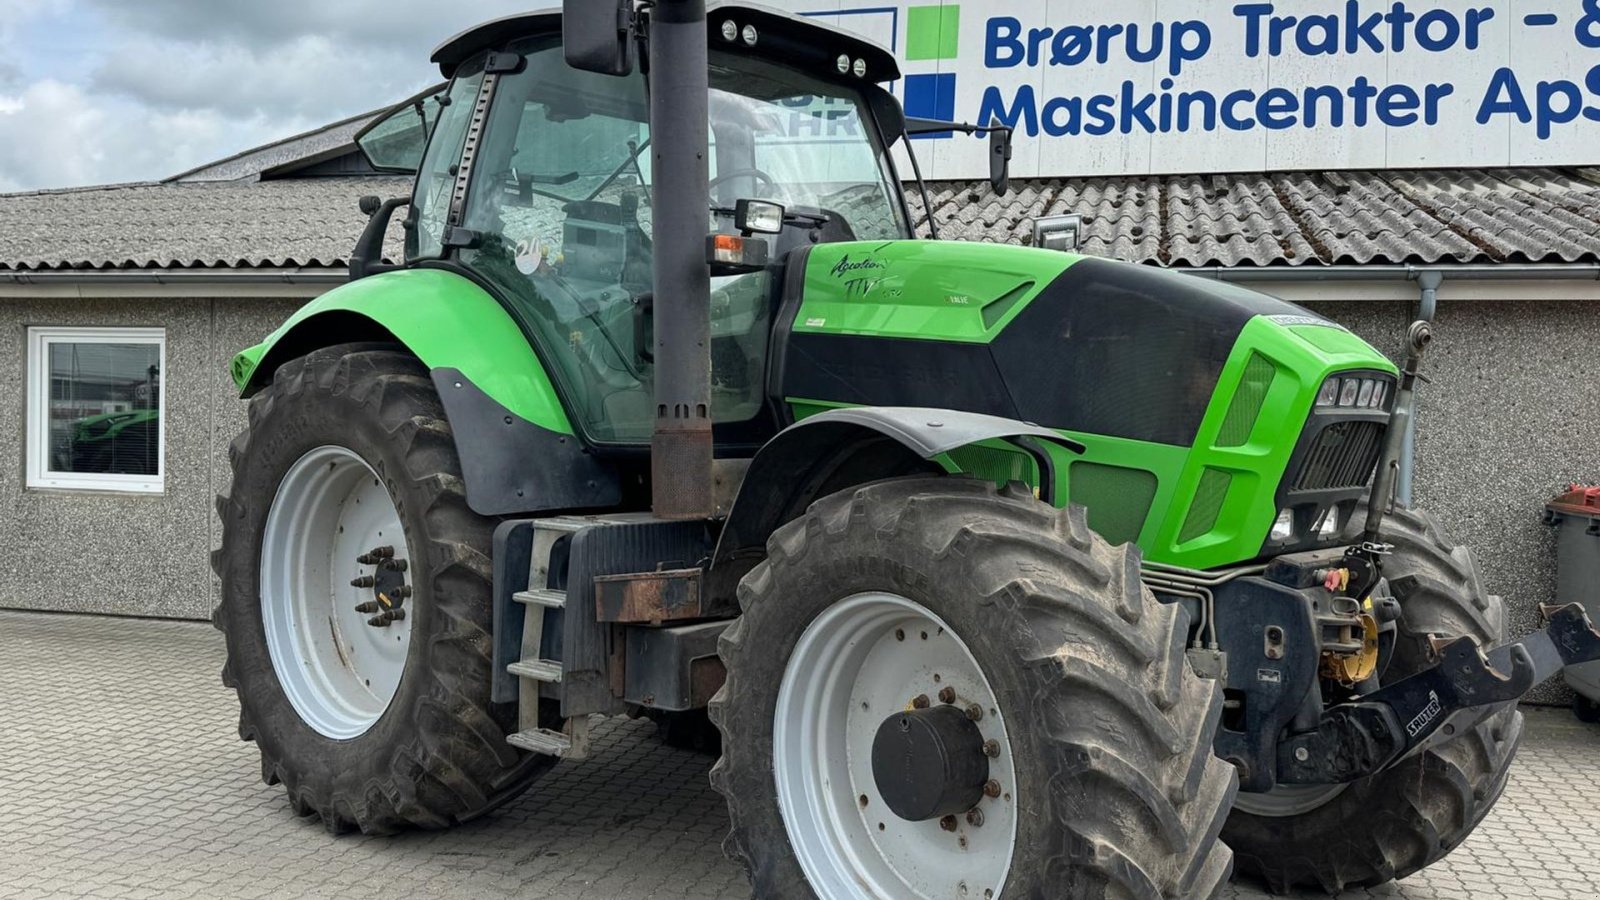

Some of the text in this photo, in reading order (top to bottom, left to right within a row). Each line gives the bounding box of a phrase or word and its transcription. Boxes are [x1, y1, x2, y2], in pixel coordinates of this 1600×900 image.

[984, 16, 1211, 76] Brørup
[1232, 0, 1495, 58] Traktor
[975, 76, 1454, 139] Maskincenter
[1406, 700, 1441, 737] SAUTER
